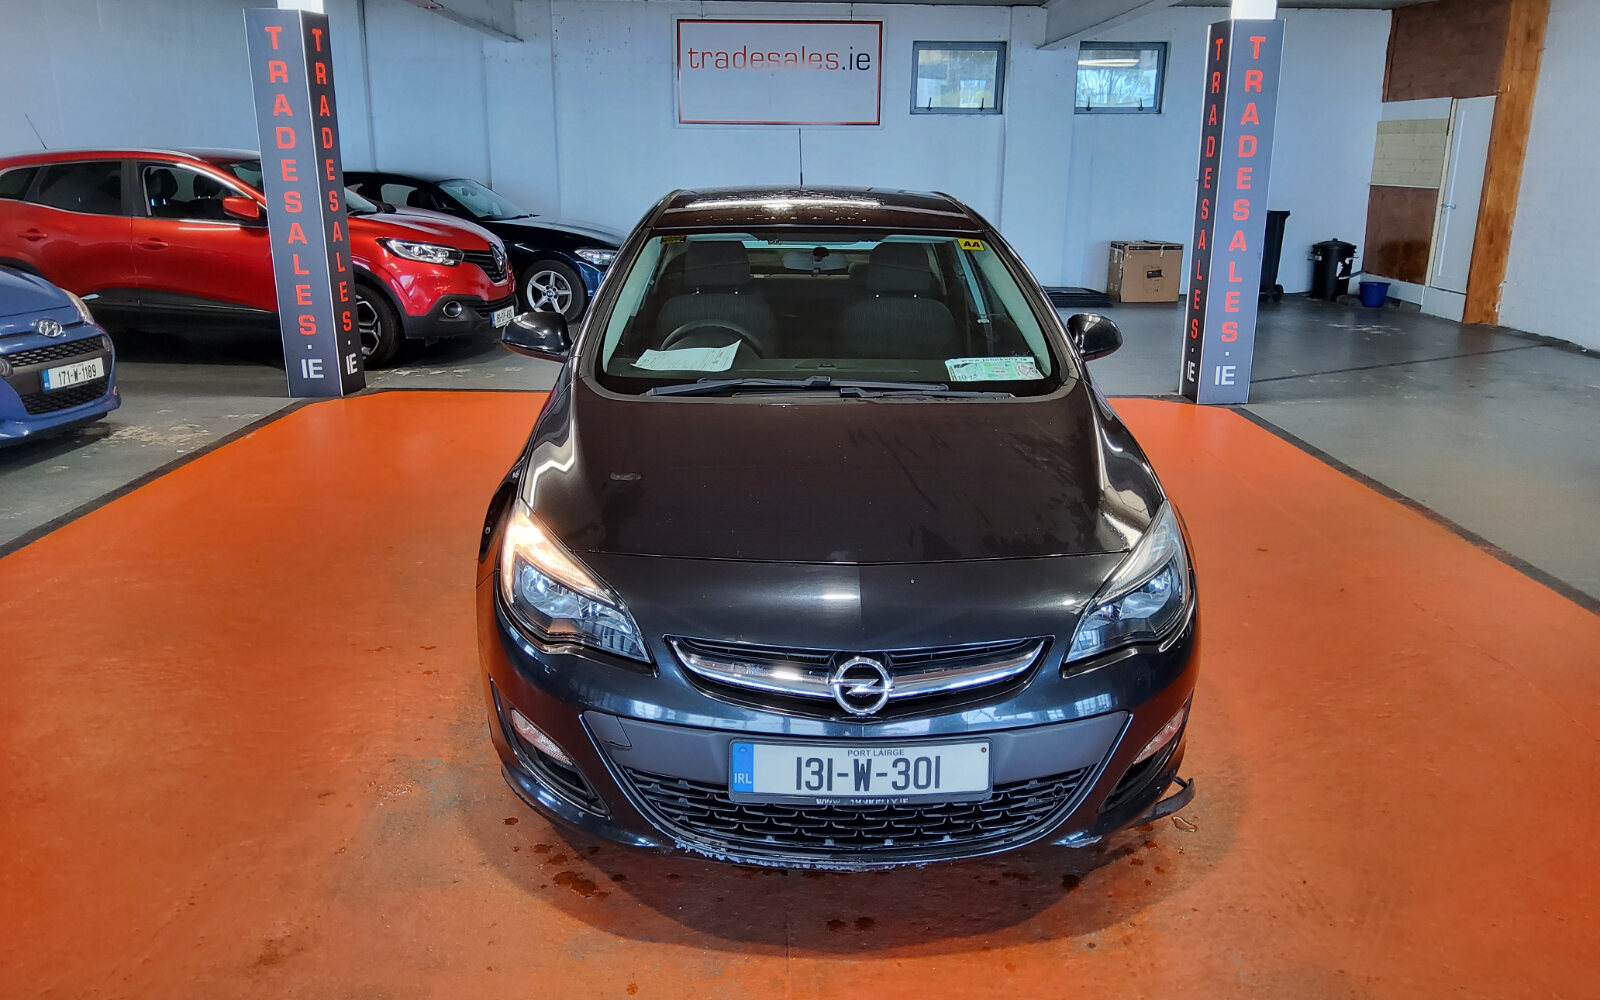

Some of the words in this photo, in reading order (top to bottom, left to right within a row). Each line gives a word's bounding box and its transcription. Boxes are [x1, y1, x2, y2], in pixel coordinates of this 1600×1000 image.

[687, 45, 871, 71] tradesales.ie
[963, 240, 981, 248] AA
[58, 363, 97, 386] 171-W-1189
[847, 749, 871, 757] PORT
[873, 748, 905, 757] LÁIRGE
[734, 772, 752, 785] IRL
[795, 755, 941, 792] 131-W-301
